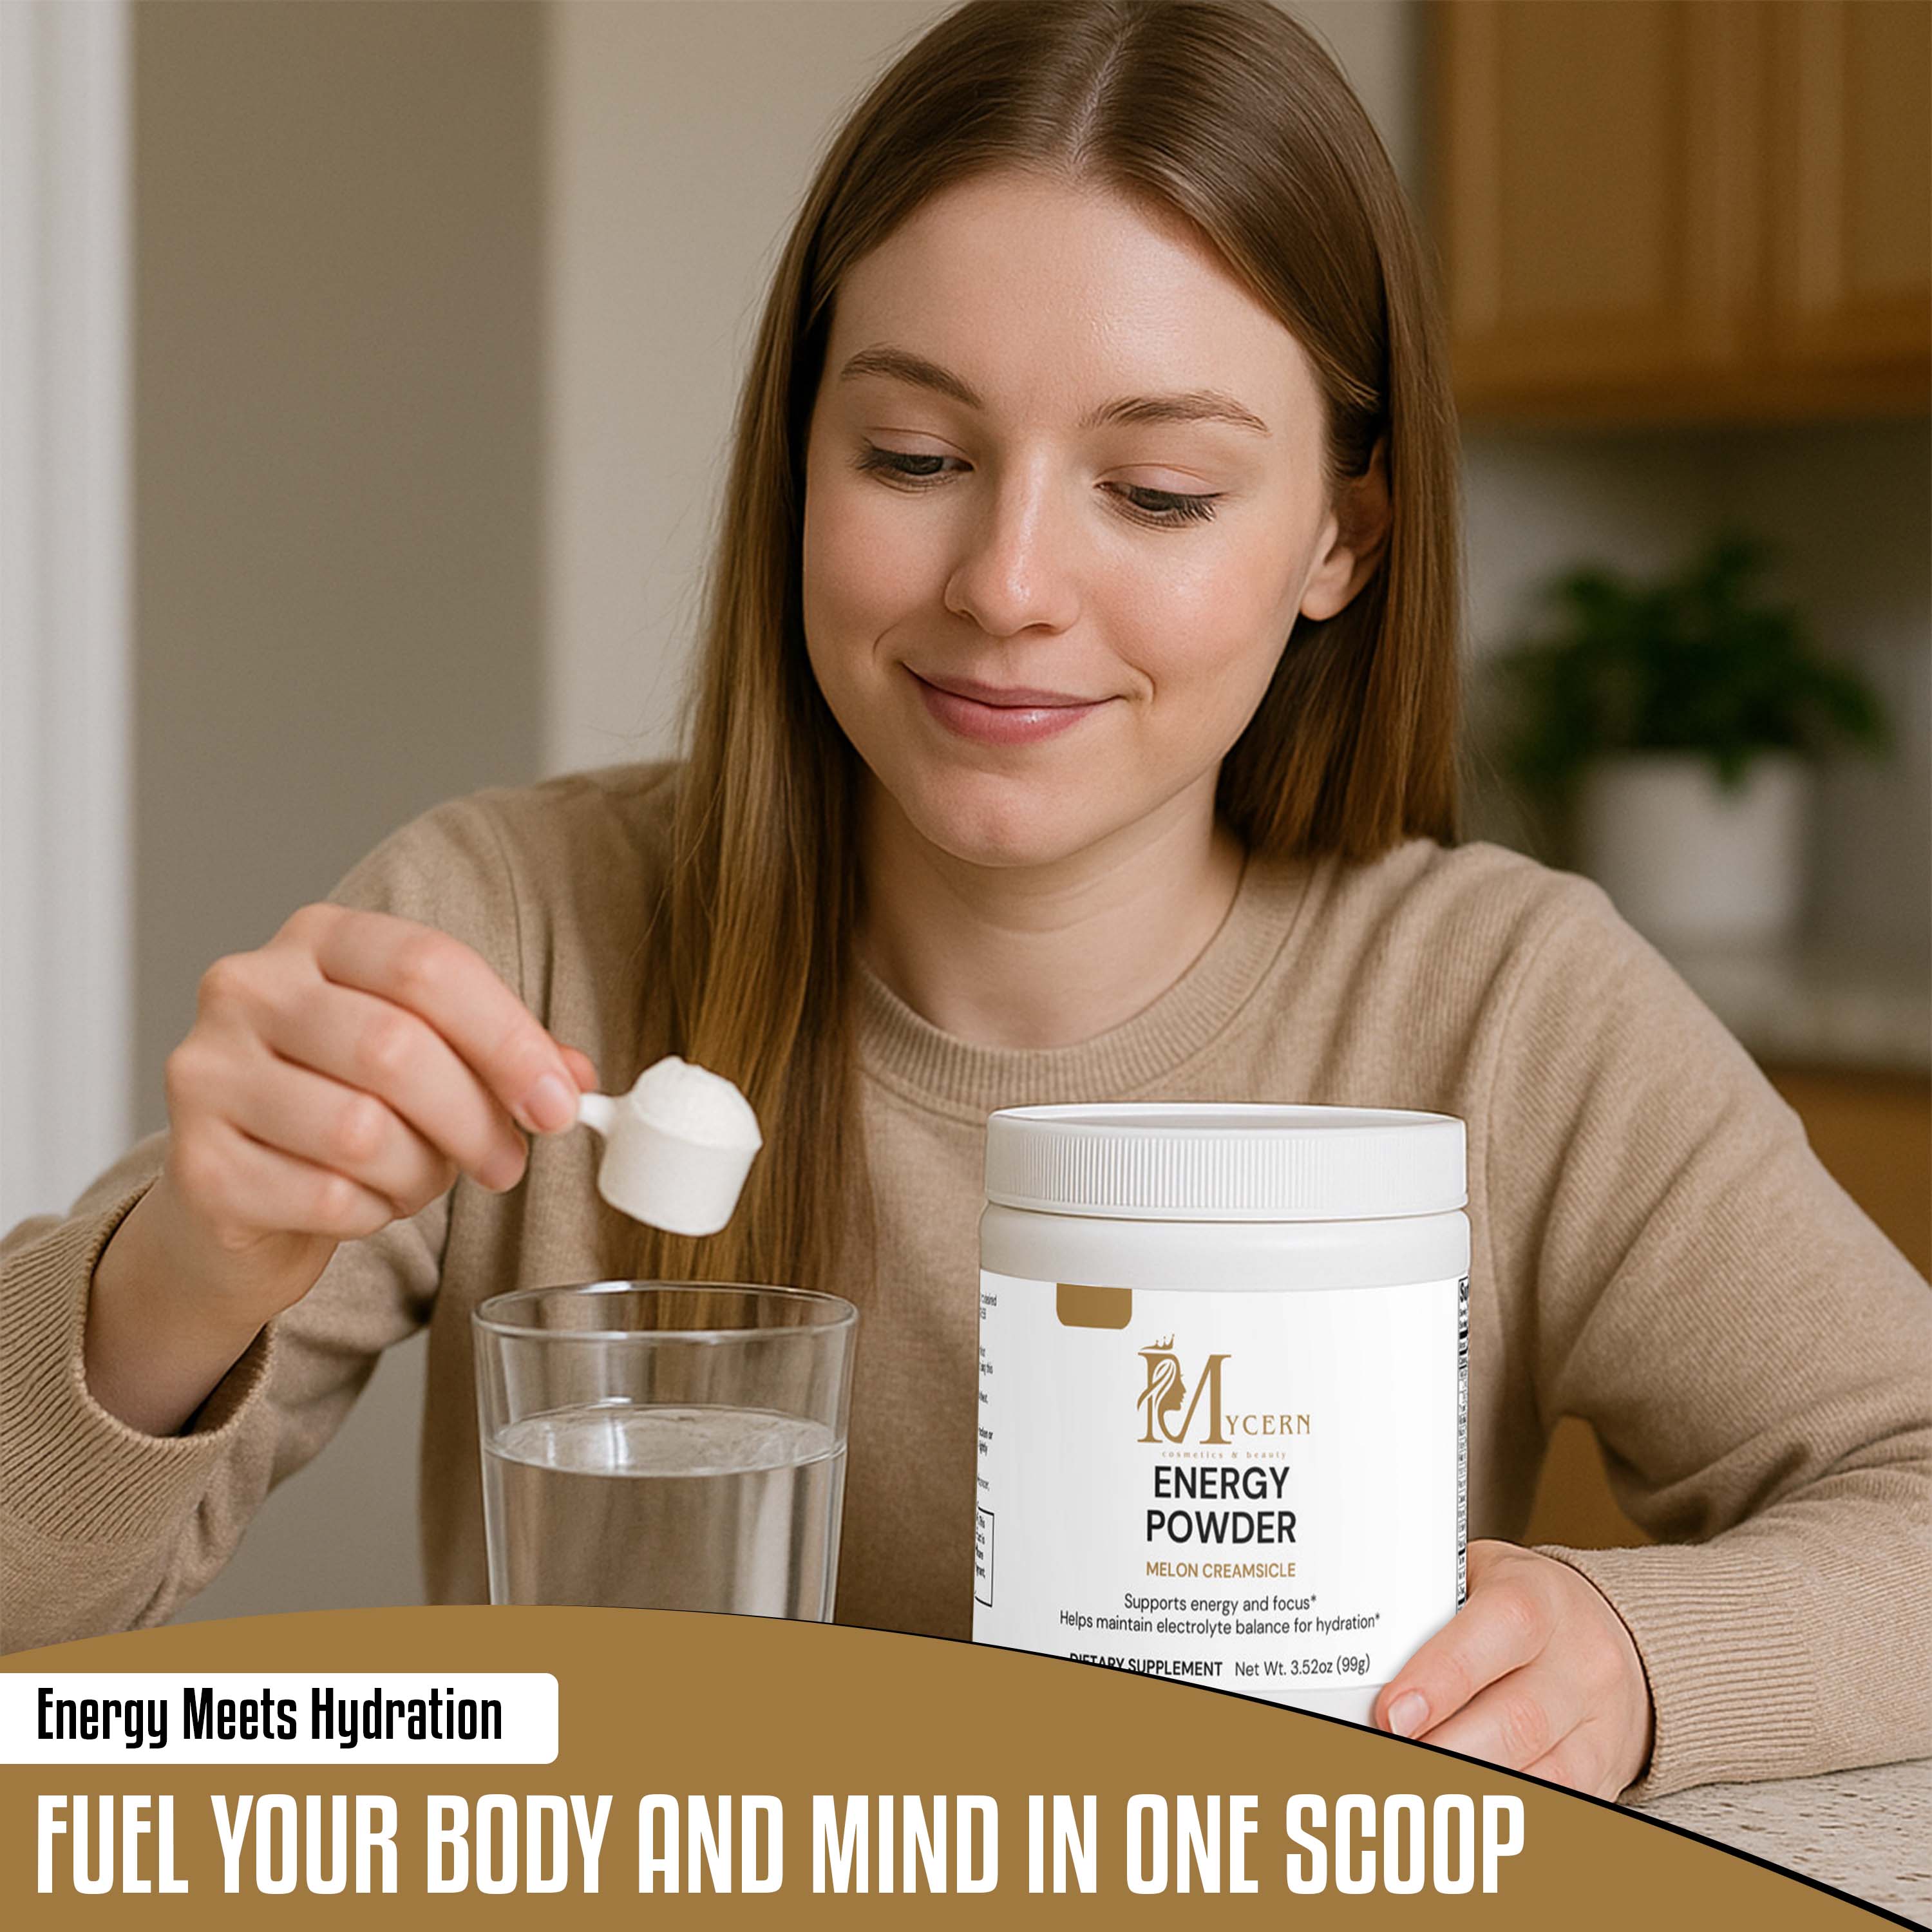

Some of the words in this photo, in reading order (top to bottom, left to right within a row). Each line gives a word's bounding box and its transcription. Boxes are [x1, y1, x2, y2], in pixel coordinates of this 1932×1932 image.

[1161, 1450, 1224, 1459] cosmetics
[1246, 1450, 1287, 1461] beauty
[1154, 1465, 1291, 1501] ENERGY
[1146, 1509, 1297, 1544] POWDER
[1146, 1561, 1198, 1578] MELON
[1202, 1562, 1296, 1578] CREAMSICLE
[1124, 1593, 1187, 1612] Supports
[1190, 1598, 1239, 1616] energy
[1242, 1595, 1269, 1612] and
[1059, 1609, 1094, 1629] Helps
[1095, 1614, 1153, 1633] maintain
[1156, 1617, 1232, 1639] electrolyte
[1235, 1618, 1291, 1635] balance
[1293, 1616, 1313, 1634] for
[1128, 1658, 1224, 1677] SUPPLEMENT
[1235, 1661, 1260, 1677] Net
[1263, 1660, 1287, 1677] Wt.
[1290, 1658, 1333, 1676] 3.52oz
[1336, 1653, 1371, 1676] (99g)
